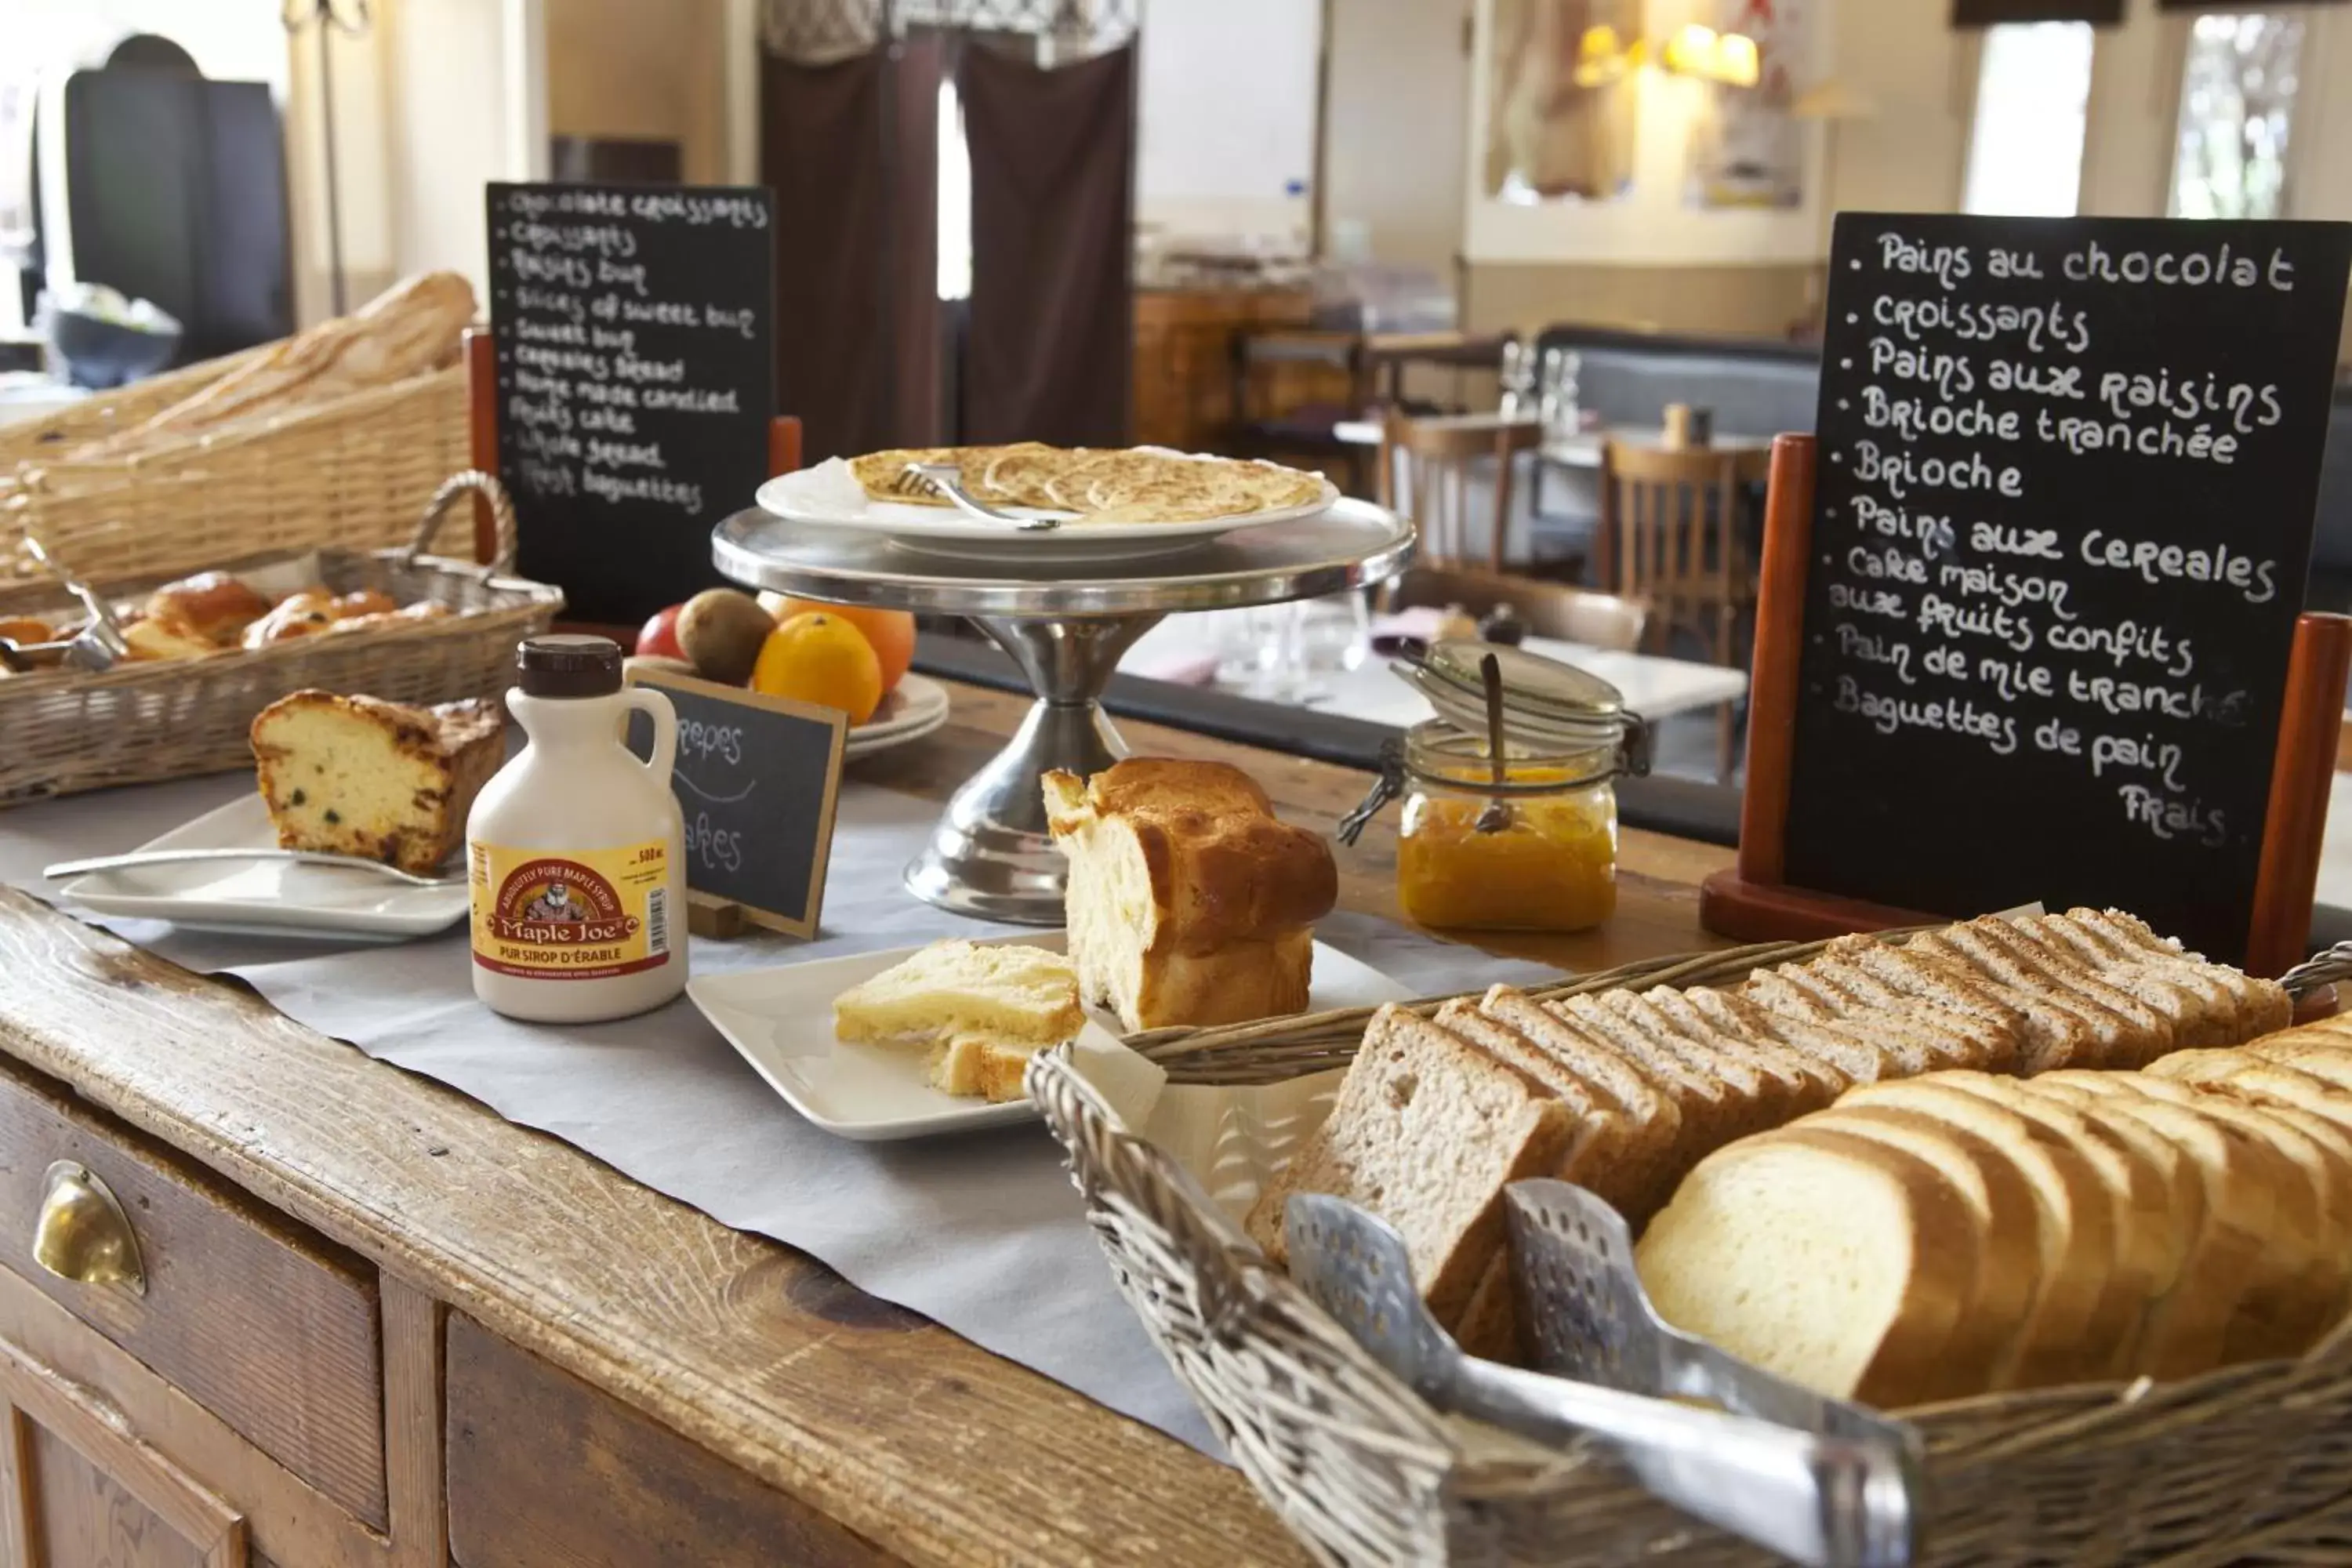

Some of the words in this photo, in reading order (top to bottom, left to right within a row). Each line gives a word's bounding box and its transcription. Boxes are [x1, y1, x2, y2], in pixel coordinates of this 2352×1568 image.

[1878, 233, 1972, 290] Pains
[1987, 248, 2044, 279] au
[2063, 241, 2295, 291] chocolat
[1869, 337, 1975, 402] Pains
[1988, 361, 2085, 399] aux
[1862, 385, 2020, 442] Brioche
[2037, 408, 2238, 464] tranchée
[1854, 439, 2024, 499] Brioche
[1850, 495, 1955, 561] Pains
[1970, 521, 2064, 560] aux
[1939, 563, 2078, 619] maison
[1829, 583, 1907, 618] aux
[1917, 593, 2033, 652] fruits
[2047, 620, 2194, 677] confits
[1836, 622, 1916, 684] Pain
[1923, 644, 1969, 680] de
[1980, 656, 2054, 702] mie
[1833, 674, 2018, 754] Baguettes
[2034, 717, 2082, 755] de
[2092, 731, 2185, 792] pain
[501, 868, 538, 909] ABSOLUTELY
[537, 866, 562, 877] PURE
[564, 868, 595, 889] MAPLE
[592, 884, 615, 912] SYRUP
[499, 946, 520, 960] PUR
[521, 949, 558, 964] SIROP
[561, 947, 622, 964] D'ÉRABLE
[501, 919, 572, 945] Maple
[578, 923, 617, 942] Joe
